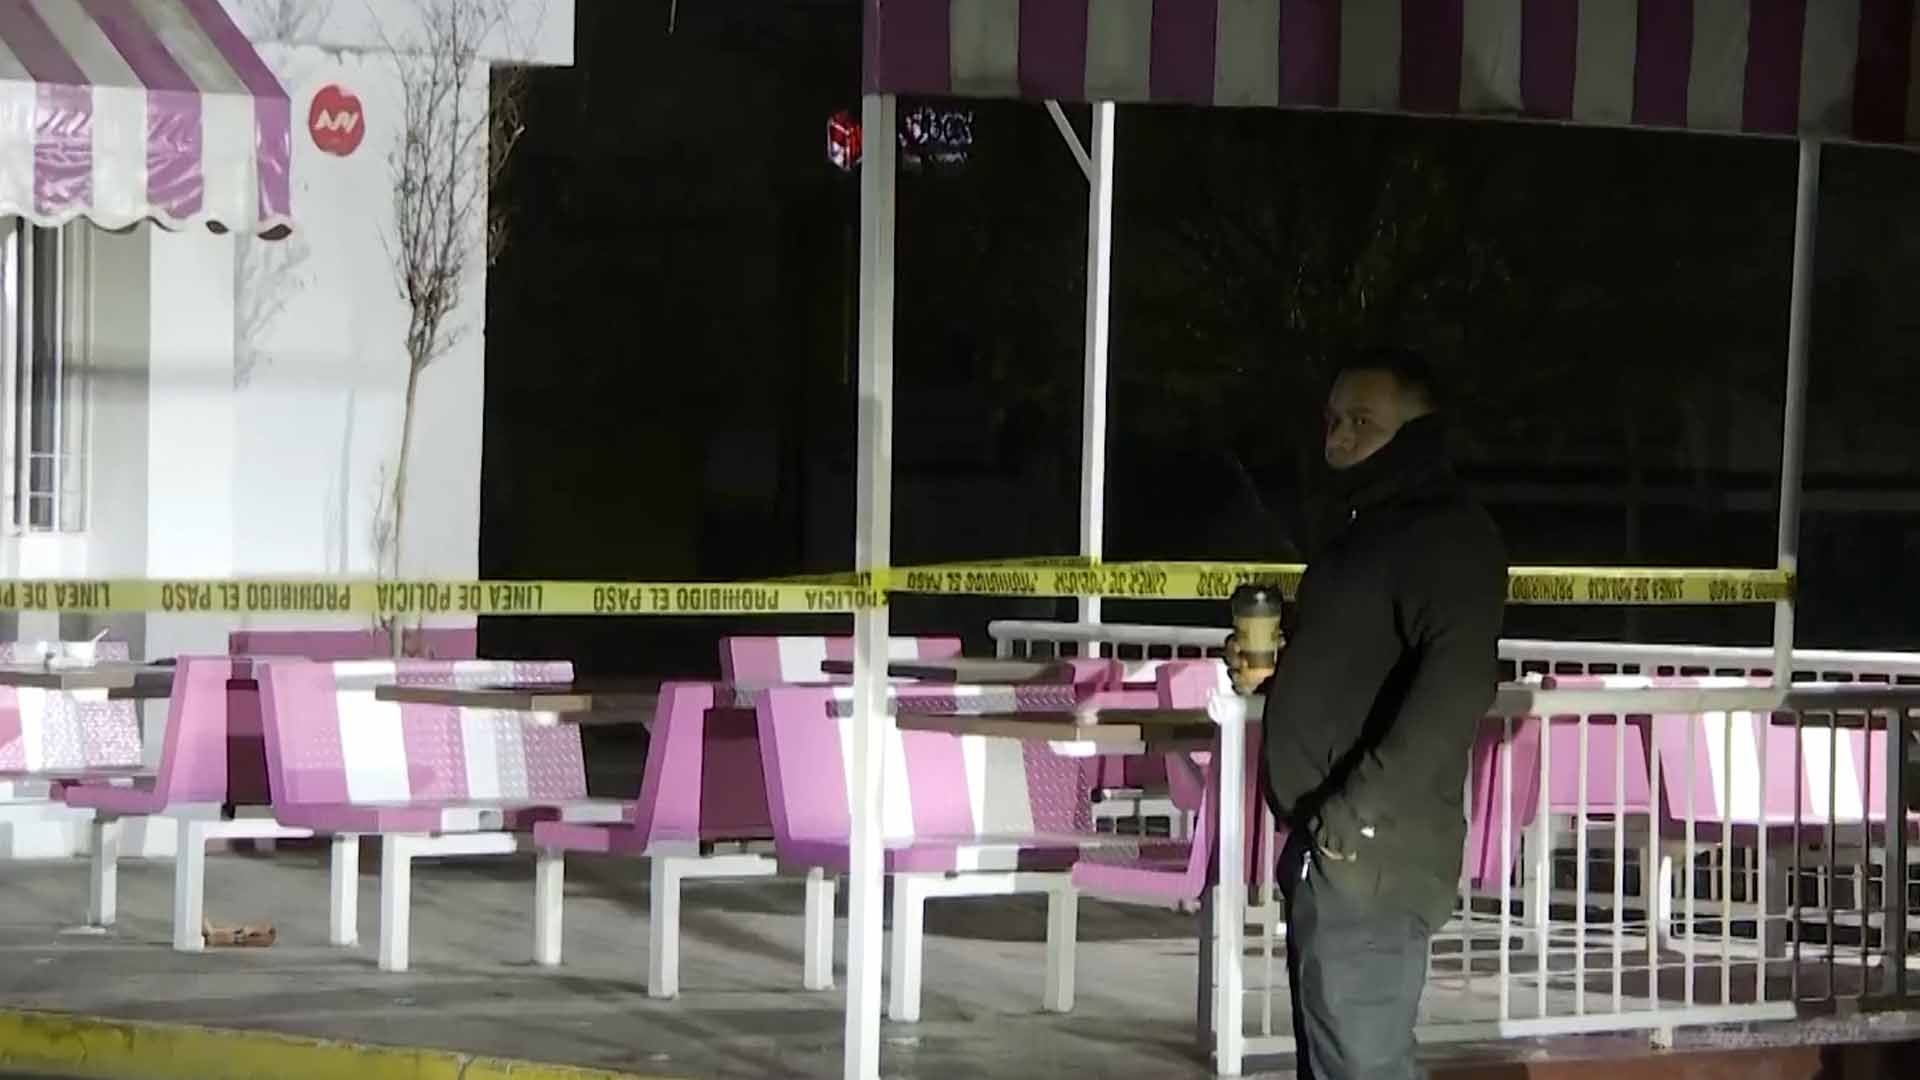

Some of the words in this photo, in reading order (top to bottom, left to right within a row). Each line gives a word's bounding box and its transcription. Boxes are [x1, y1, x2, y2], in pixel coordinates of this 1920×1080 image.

[23, 583, 48, 610] DE
[54, 582, 110, 610] LINEA
[161, 583, 212, 612] PASO
[219, 583, 240, 611] EL
[247, 583, 350, 611] PROHIBIDO
[376, 584, 450, 612] POLICIA
[458, 585, 481, 611] DE
[489, 584, 543, 611] LINEA
[594, 587, 641, 612] PASO
[649, 588, 669, 611] EL
[677, 588, 779, 611] PROHIBIDO
